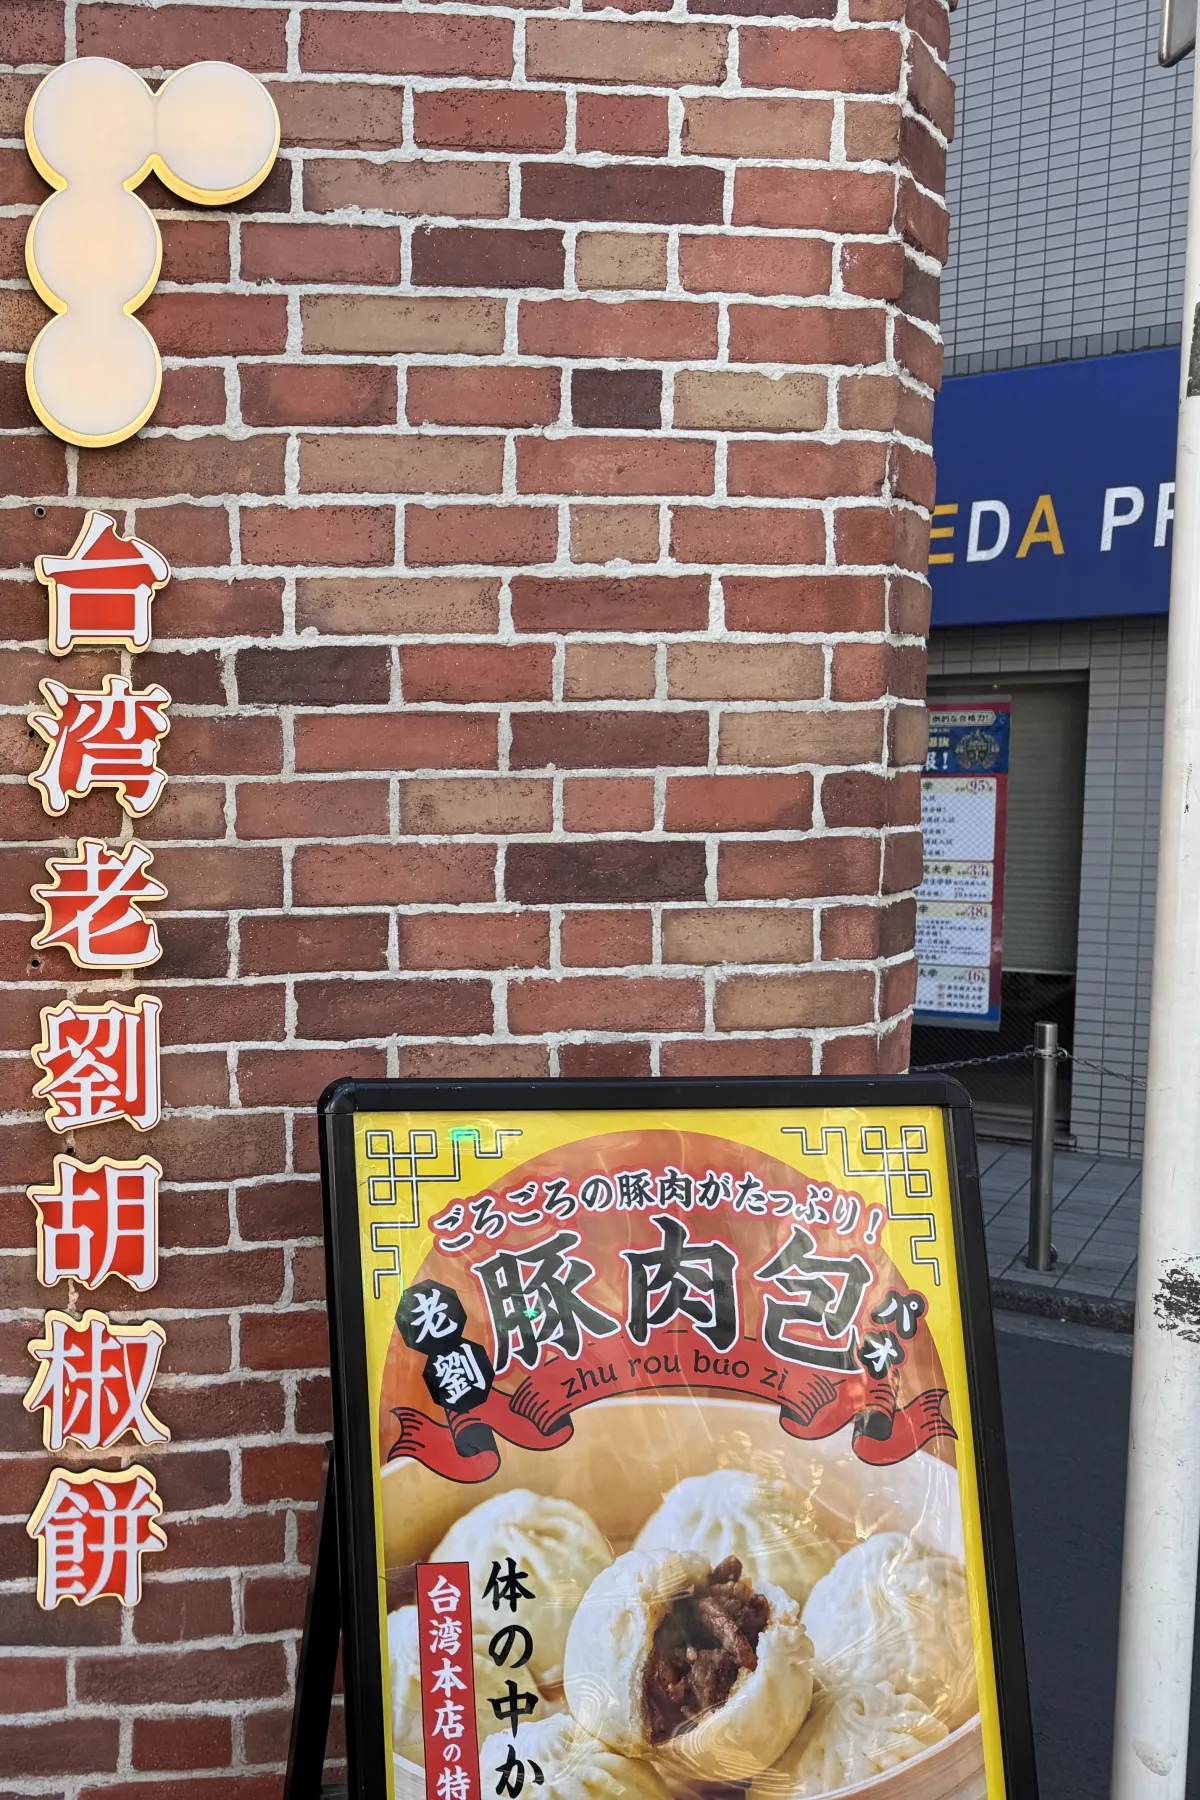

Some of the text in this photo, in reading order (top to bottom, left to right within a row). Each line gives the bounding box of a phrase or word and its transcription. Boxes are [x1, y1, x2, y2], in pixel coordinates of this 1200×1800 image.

[970, 780, 985, 791] 95
[968, 906, 983, 917] 38
[971, 864, 985, 876] 33
[27, 512, 171, 1607] 台湾老劉胡椒餅
[434, 1166, 884, 1251] ごろごろの豚肉がたっぷり!
[471, 1213, 874, 1374] 豚肉包
[862, 1297, 919, 1373] パオ
[411, 1289, 486, 1404] 老劉
[561, 1348, 790, 1398] zhu rou bao zi
[426, 1574, 472, 1800] 台湾本店の特
[482, 1556, 545, 1799] 体の中か
